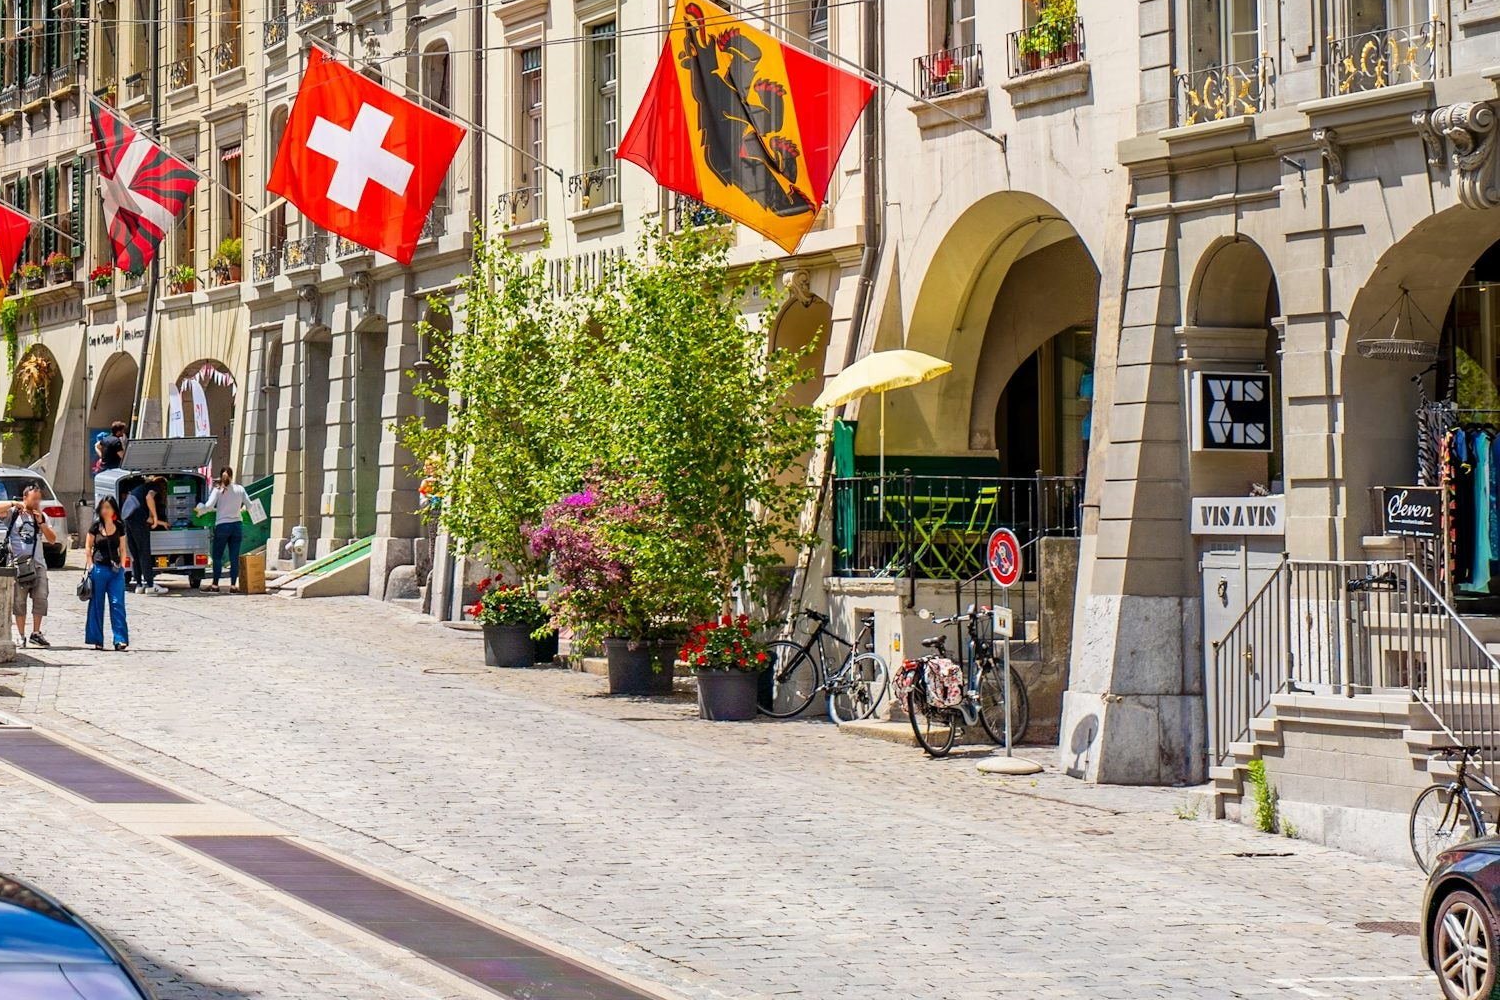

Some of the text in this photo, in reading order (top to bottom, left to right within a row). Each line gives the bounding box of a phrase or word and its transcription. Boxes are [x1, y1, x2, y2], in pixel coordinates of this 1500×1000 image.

[1207, 379, 1264, 401] VIS
[1208, 422, 1266, 444] VIS
[1200, 506, 1277, 527] VIS A VIS
[1387, 490, 1434, 522] Seven
